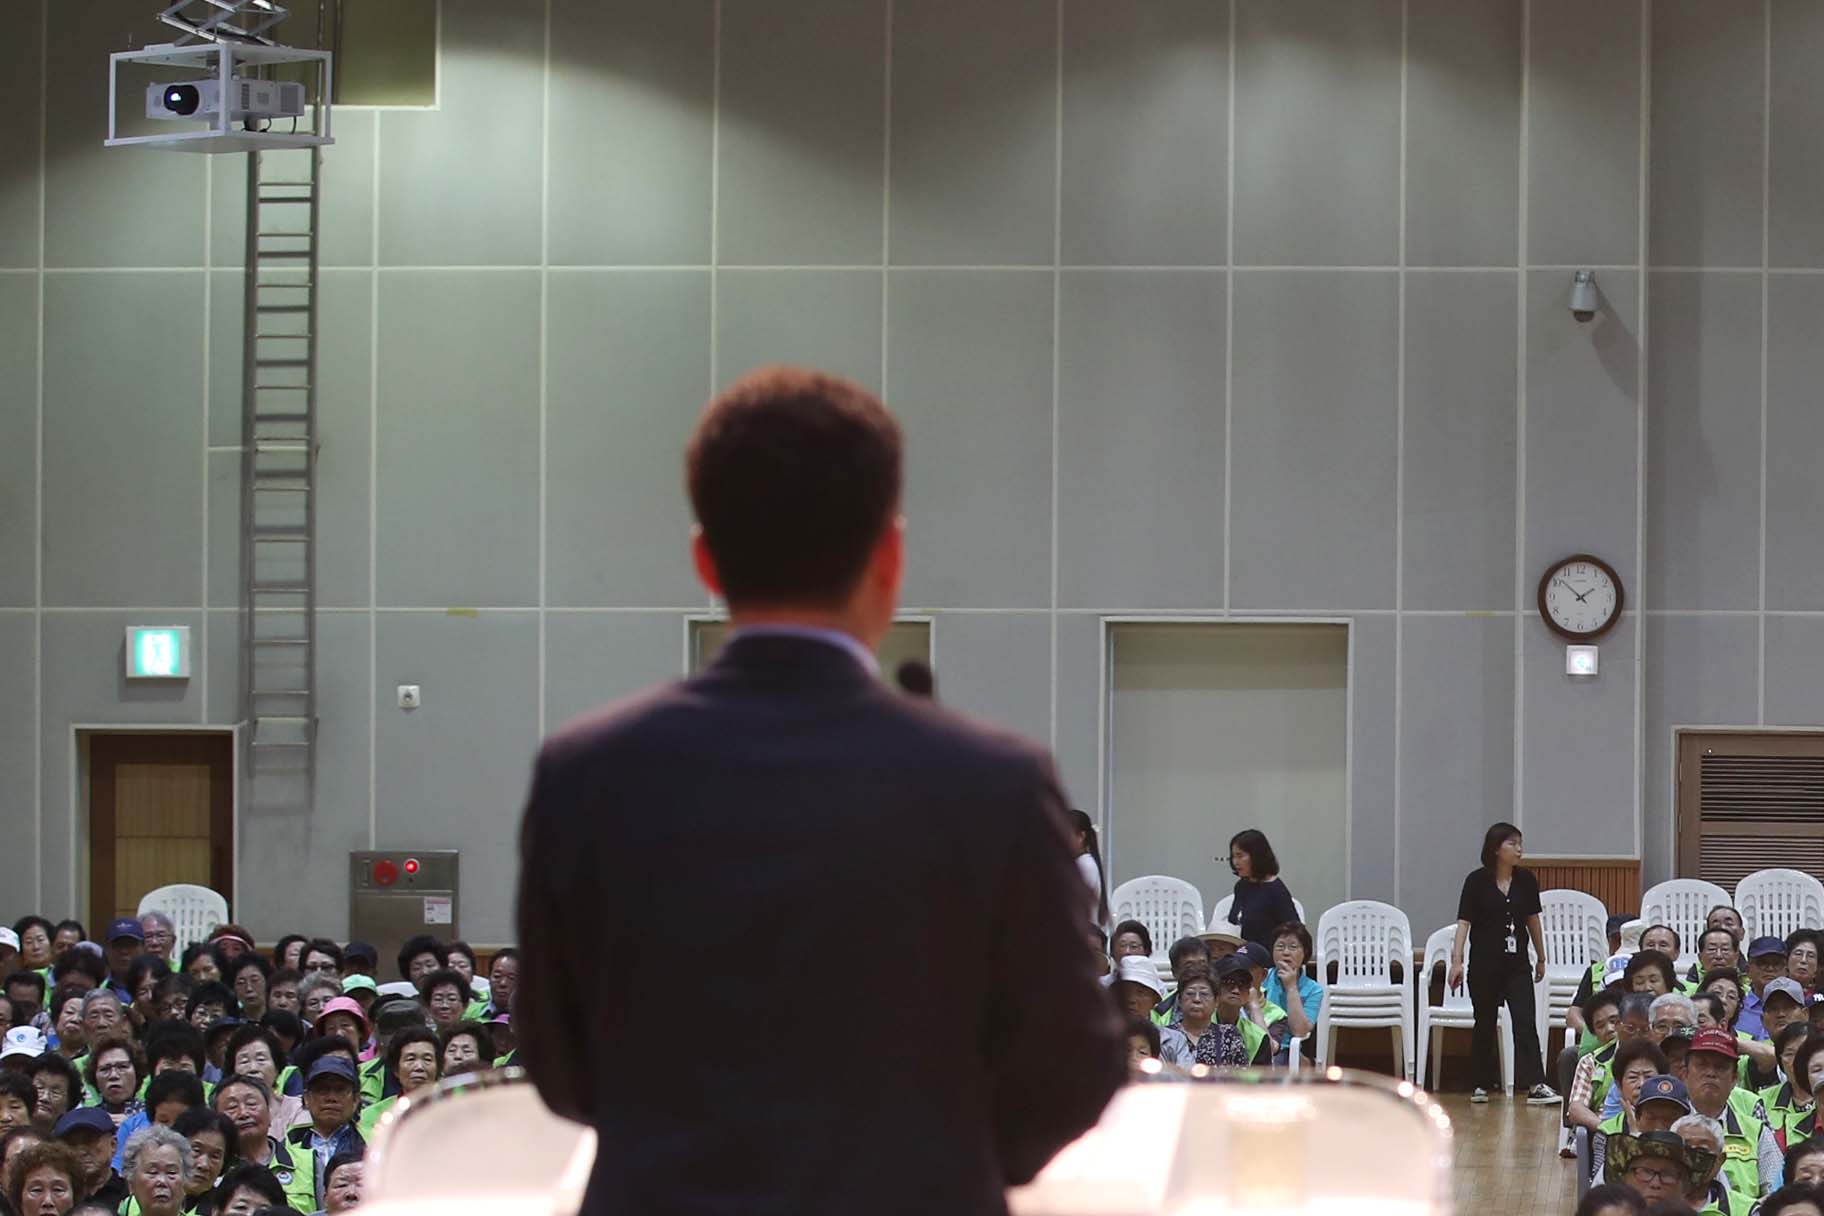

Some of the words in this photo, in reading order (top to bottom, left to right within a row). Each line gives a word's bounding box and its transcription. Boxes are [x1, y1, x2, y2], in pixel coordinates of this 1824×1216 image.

[1563, 567, 1570, 577] 11
[1576, 564, 1586, 574] 12
[1602, 577, 1608, 588] 2
[1549, 592, 1556, 600] 9
[1576, 623, 1584, 631] 6
